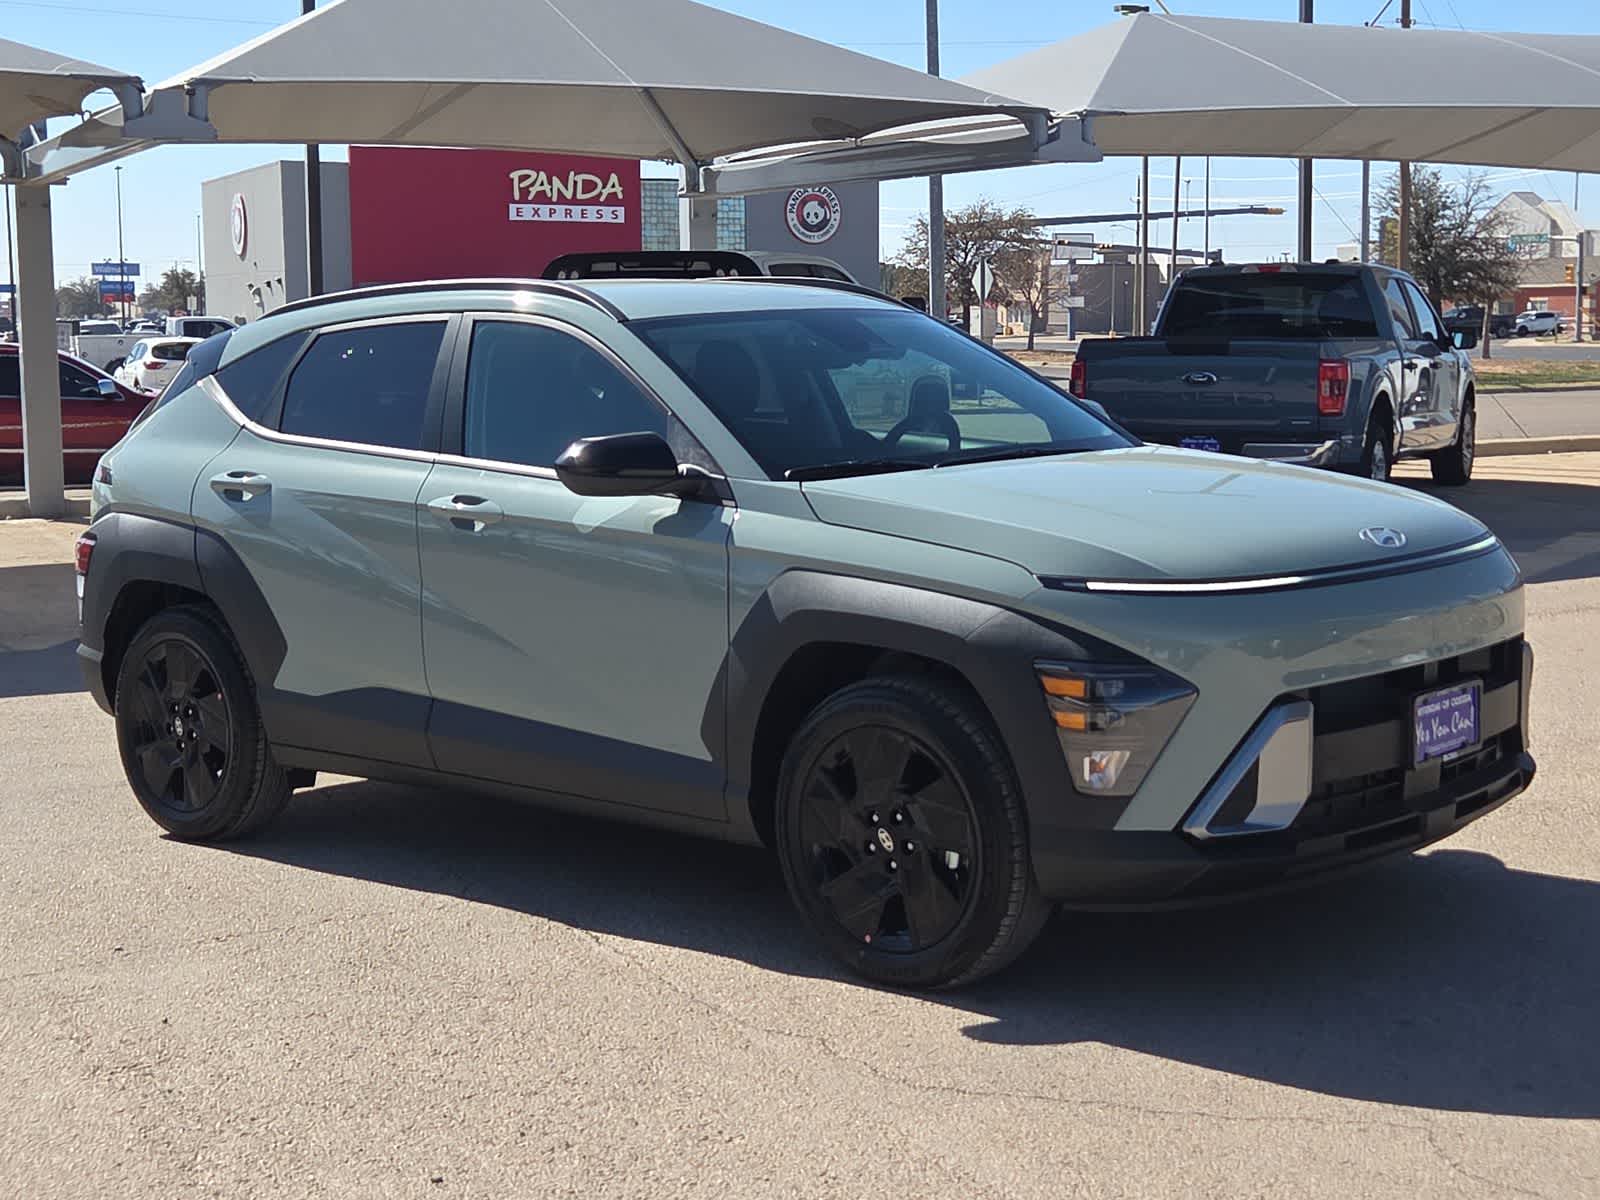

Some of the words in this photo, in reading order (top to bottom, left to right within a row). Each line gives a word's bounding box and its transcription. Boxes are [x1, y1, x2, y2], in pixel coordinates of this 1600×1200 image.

[509, 169, 623, 202] PANDA
[515, 207, 619, 220] EXPRESS
[95, 264, 128, 274] Walmat
[1415, 721, 1430, 745] Yes
[1431, 716, 1450, 741] You
